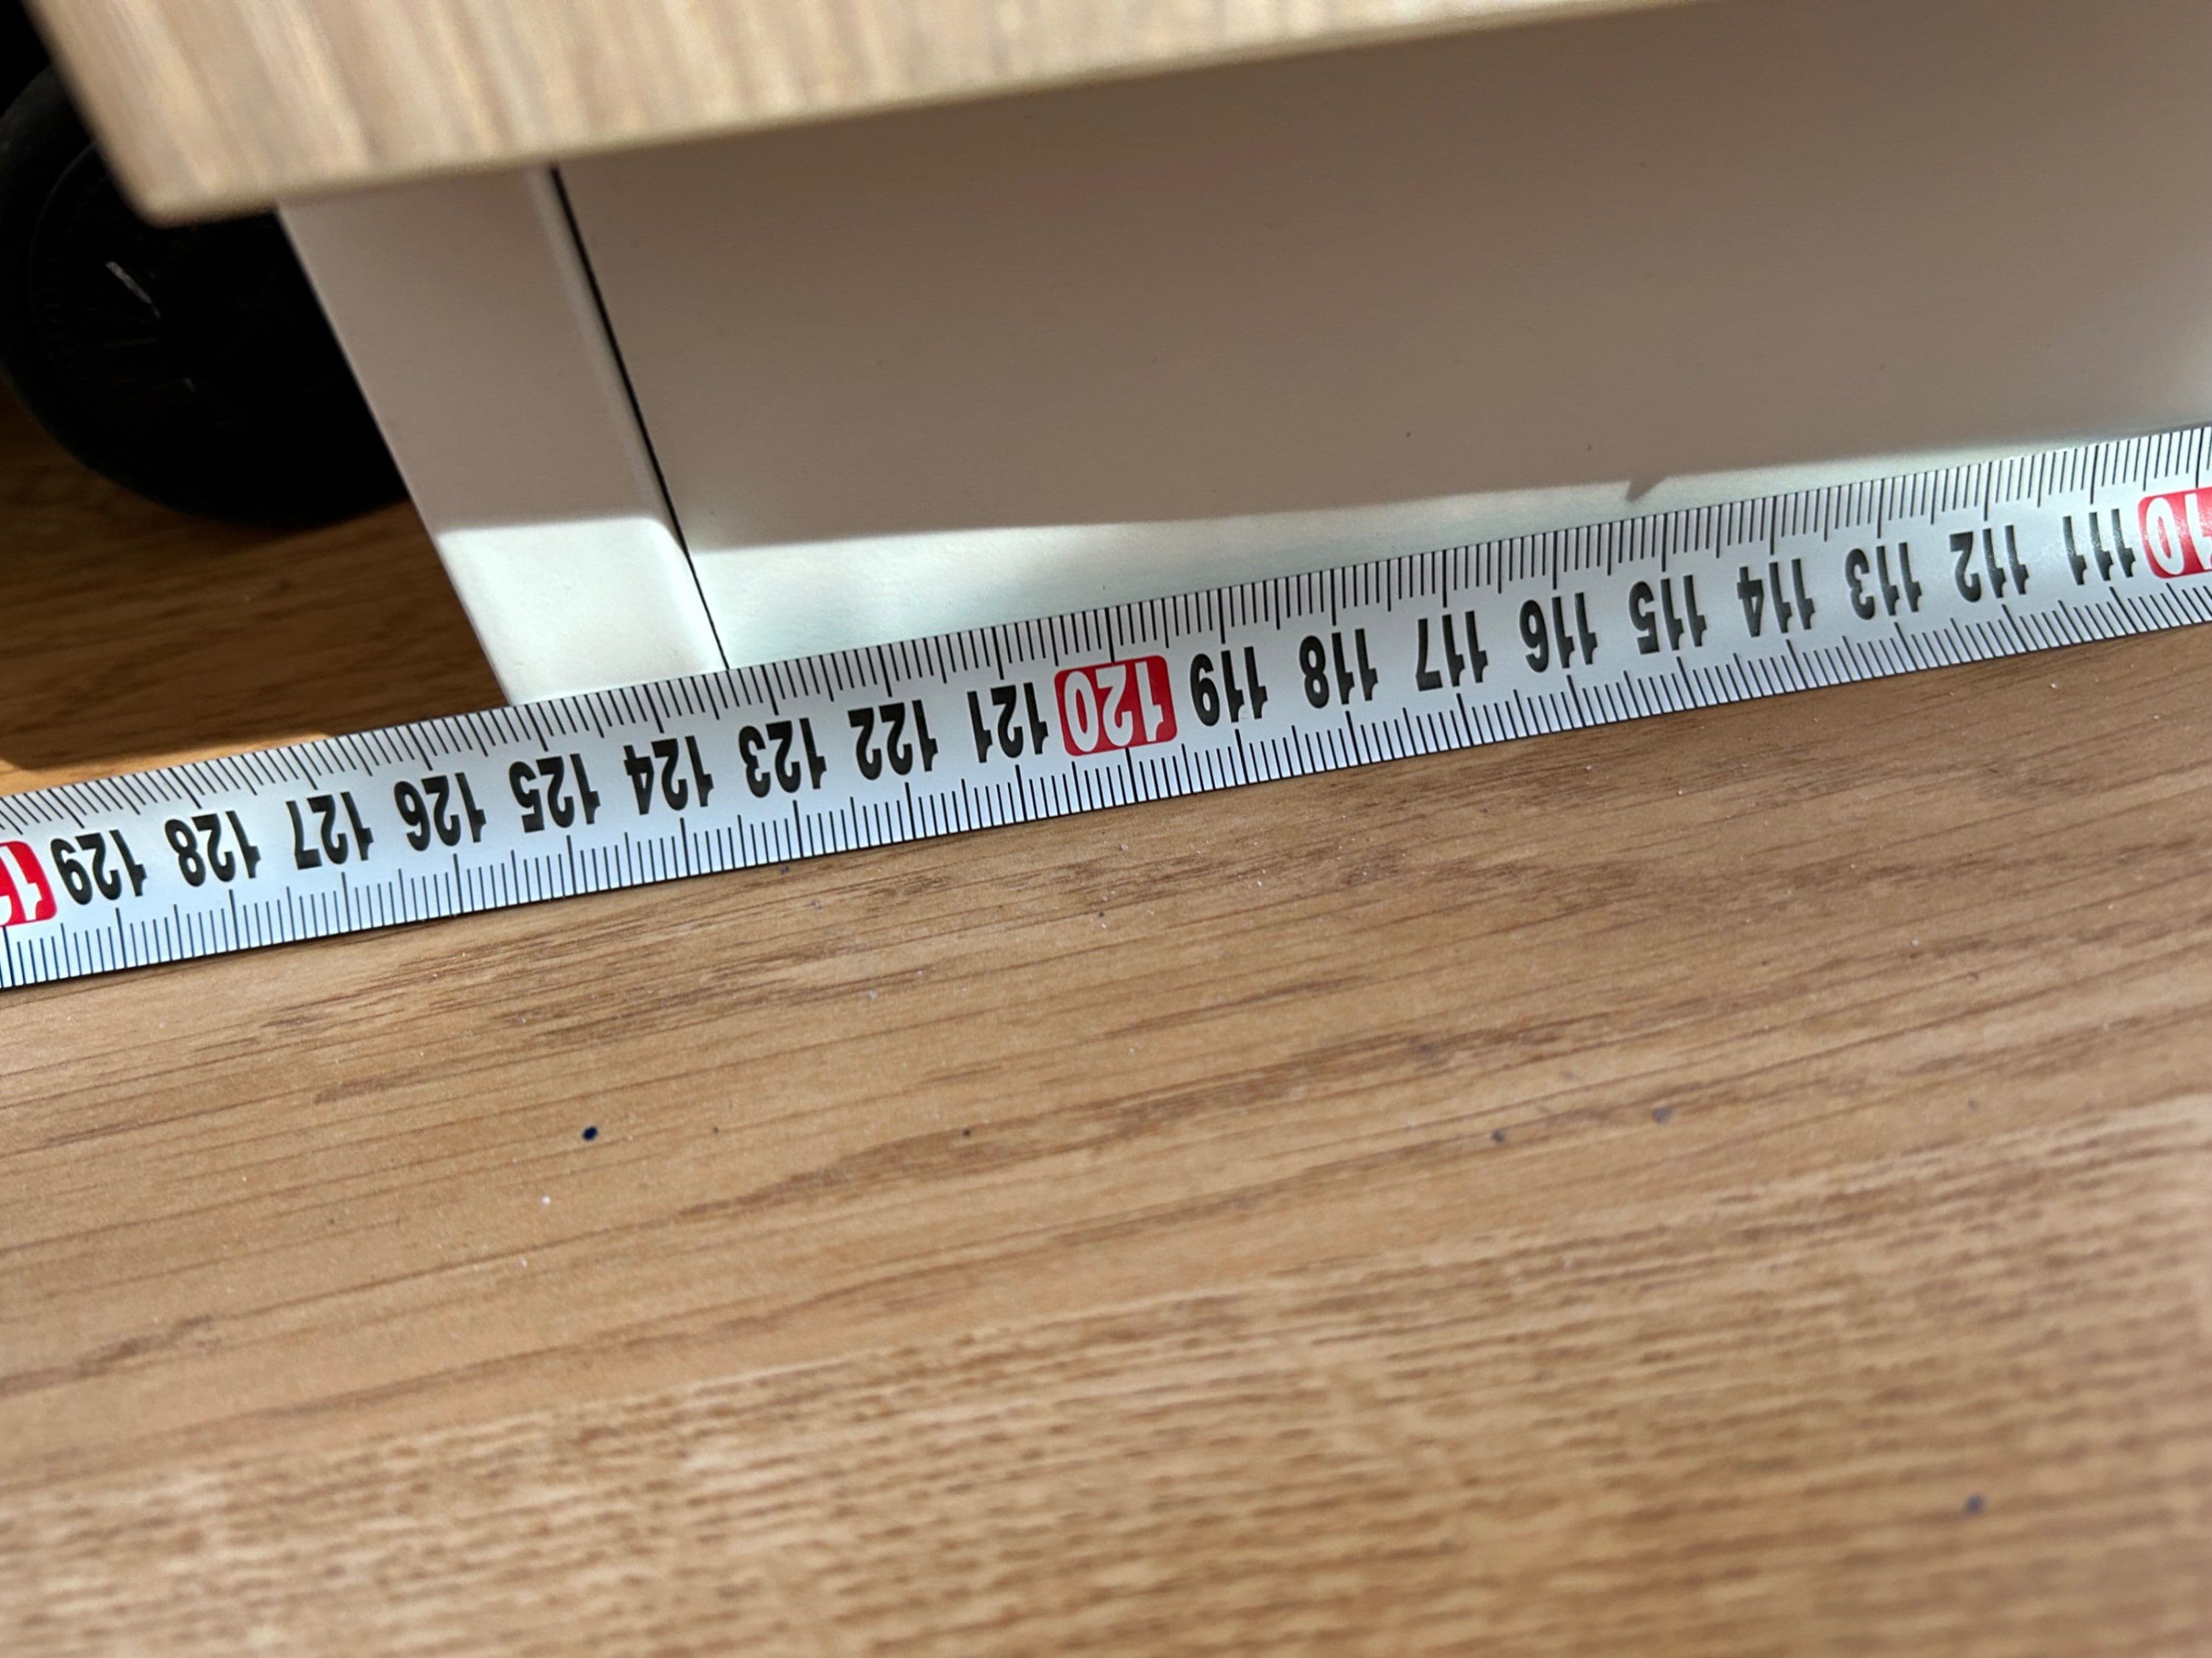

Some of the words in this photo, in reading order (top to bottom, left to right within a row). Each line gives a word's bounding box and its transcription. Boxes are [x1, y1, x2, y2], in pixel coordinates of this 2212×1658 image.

[1950, 525, 2029, 603] 112
[2063, 509, 2136, 585] 111
[2146, 492, 2212, 575] 10
[1629, 575, 1707, 654] 115
[1737, 558, 1815, 637] 114
[1845, 542, 1922, 620] 113
[1299, 628, 1378, 709] 118
[1416, 610, 1488, 691] 117
[1519, 592, 1598, 672] 116
[967, 682, 1048, 763] 121
[1064, 661, 1164, 753] 120
[1190, 646, 1267, 726] 119
[623, 736, 714, 815] 124
[738, 718, 827, 798] 123
[848, 699, 938, 780] 122
[286, 792, 373, 870] 127
[393, 772, 486, 851] 126
[509, 753, 600, 833] 125
[51, 829, 147, 905] 129
[164, 810, 260, 887] 128
